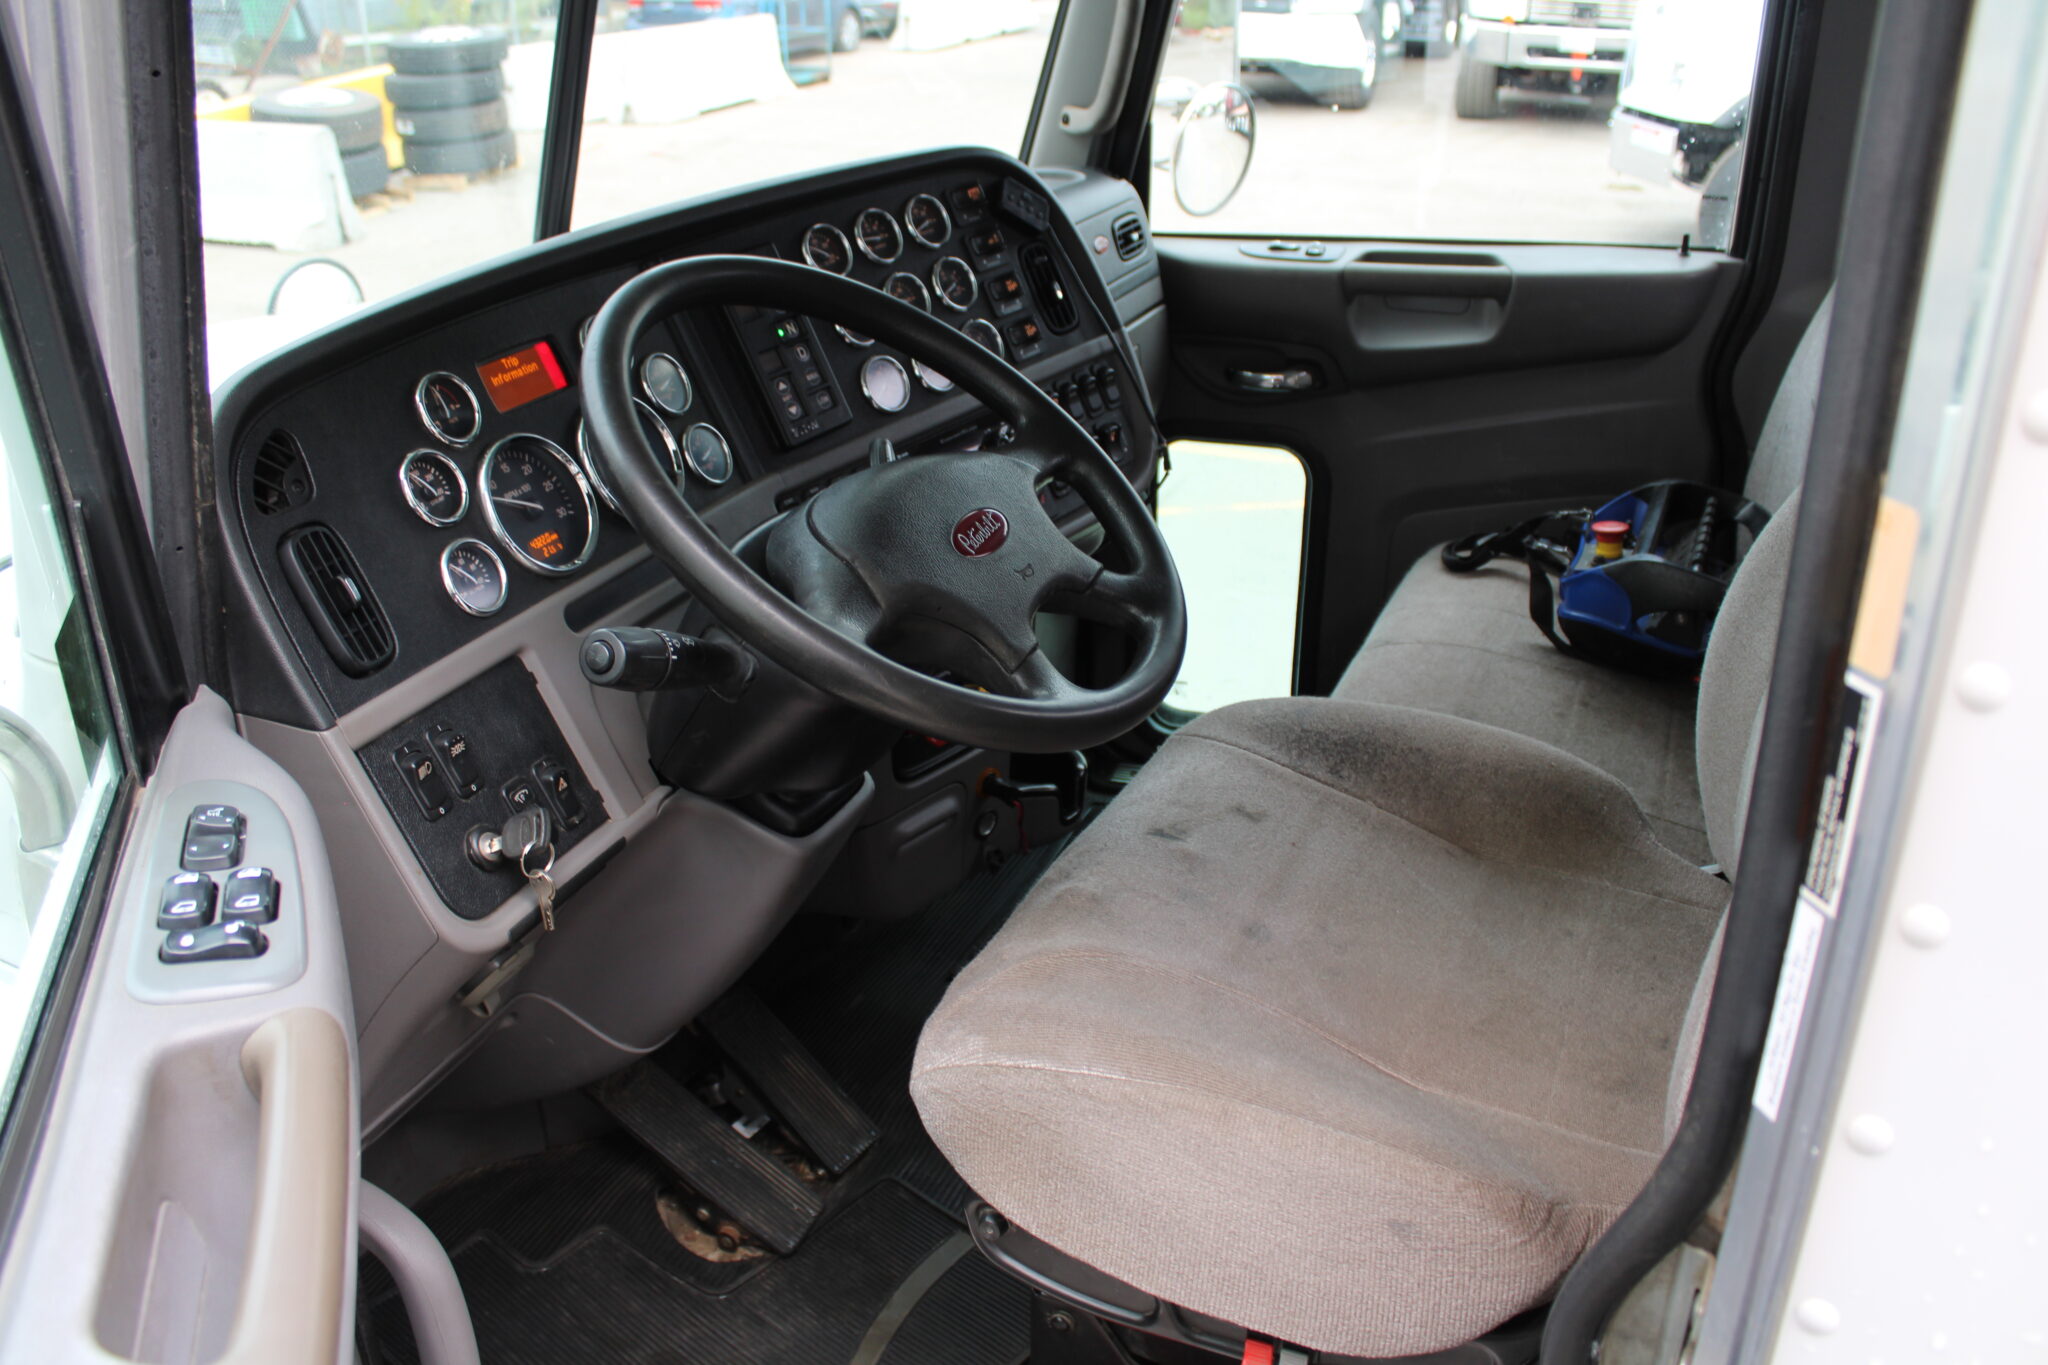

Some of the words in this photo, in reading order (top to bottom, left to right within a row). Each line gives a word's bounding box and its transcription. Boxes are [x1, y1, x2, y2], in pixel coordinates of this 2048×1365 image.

[785, 321, 798, 335] N
[795, 346, 809, 361] D
[501, 356, 519, 369] Trip
[490, 362, 539, 387] Information
[521, 464, 533, 475] 20
[542, 481, 554, 492] 25
[957, 511, 1001, 555] Peterbilt
